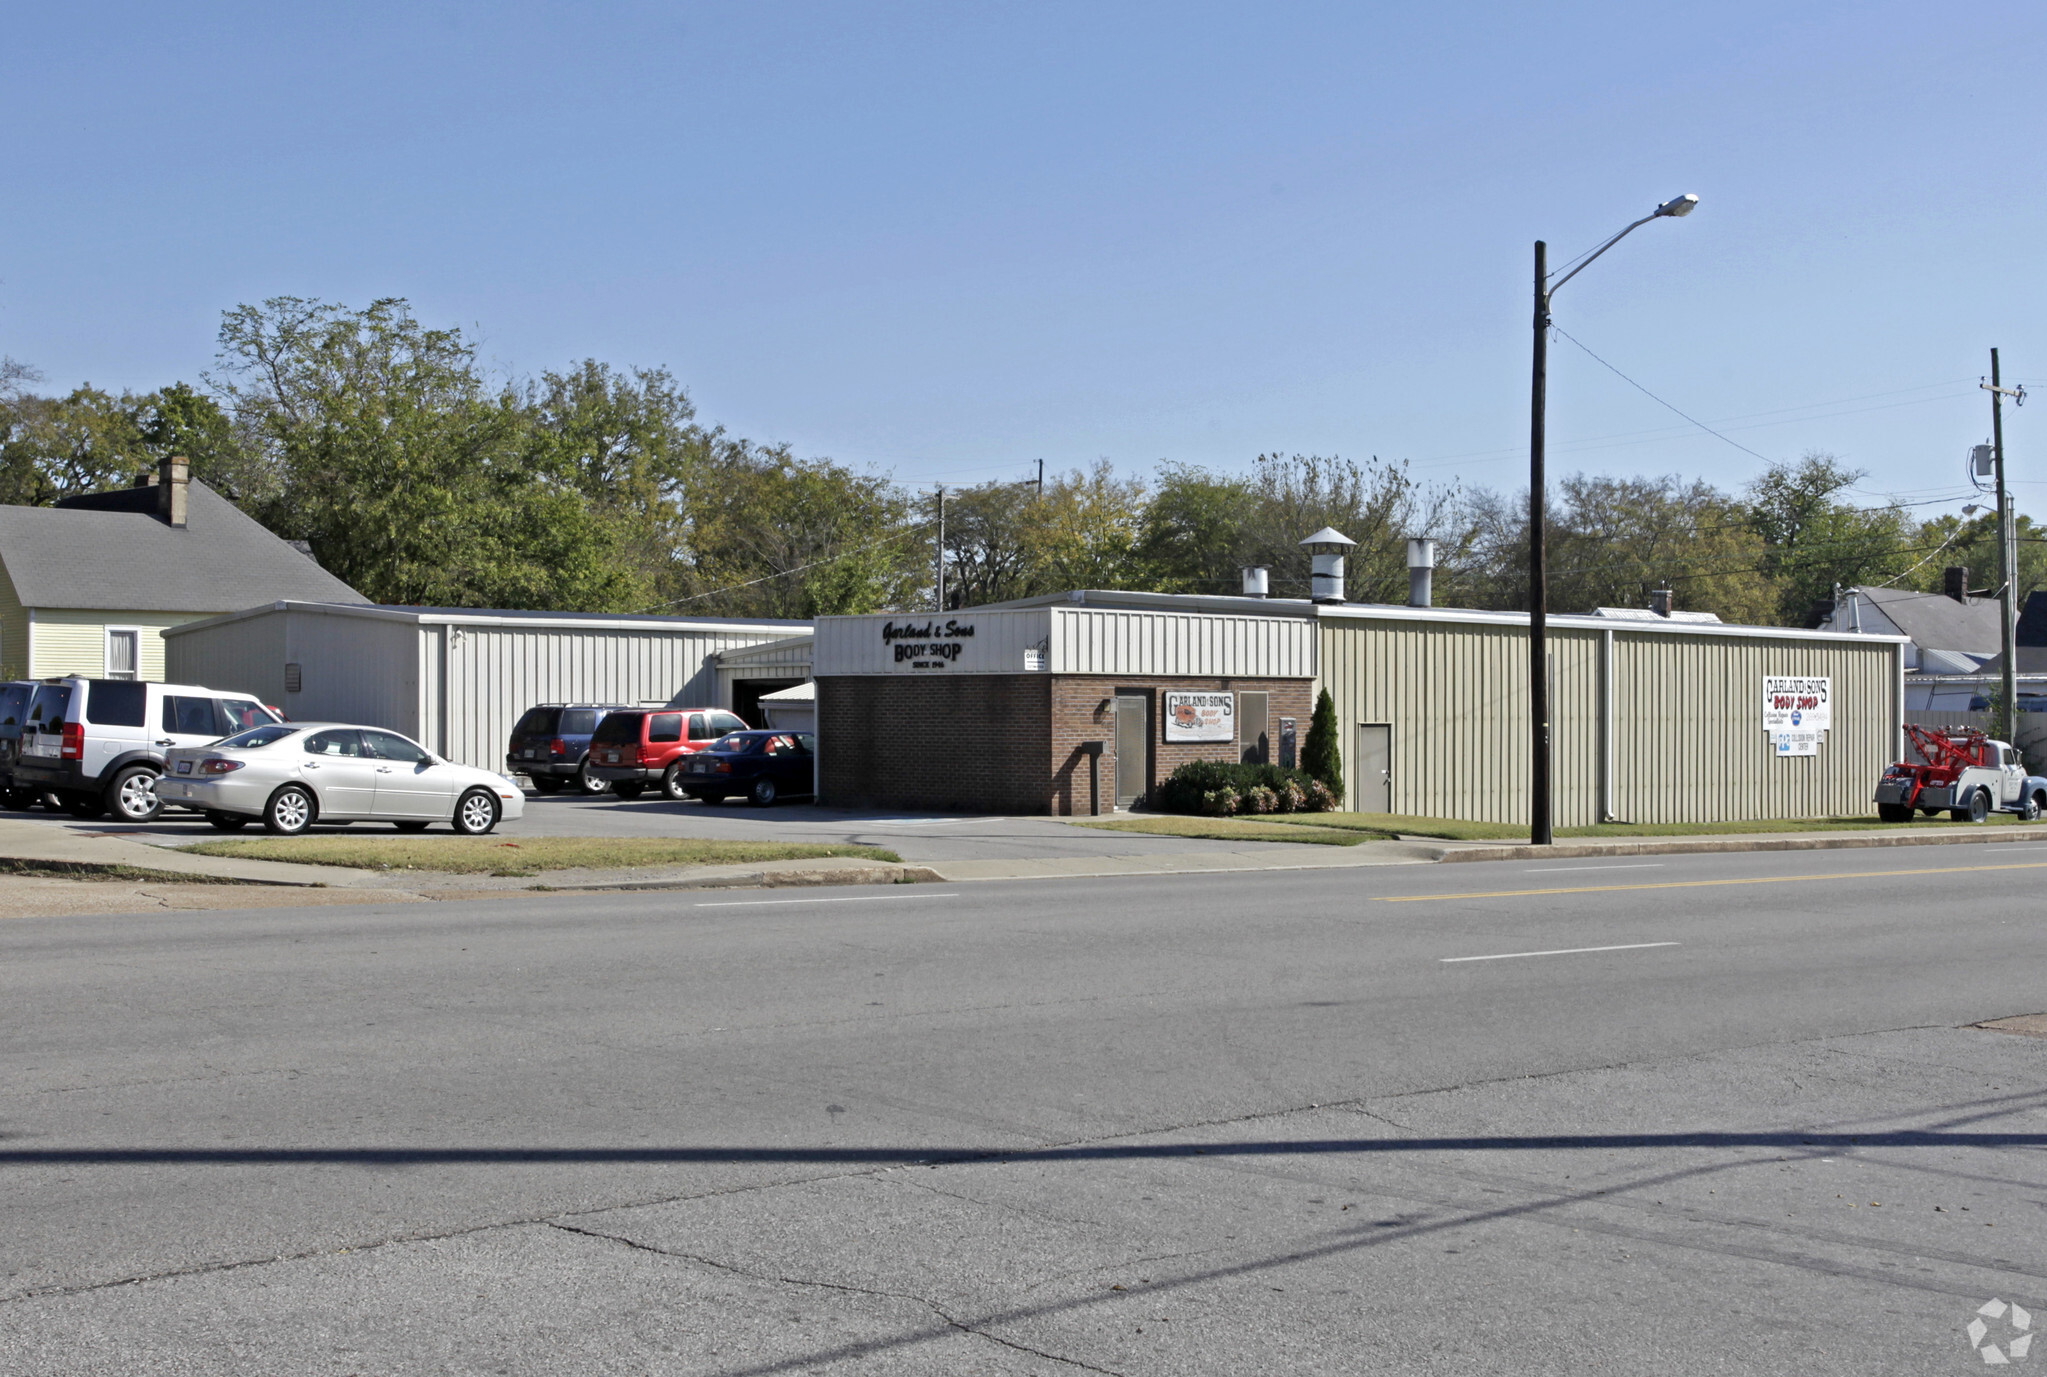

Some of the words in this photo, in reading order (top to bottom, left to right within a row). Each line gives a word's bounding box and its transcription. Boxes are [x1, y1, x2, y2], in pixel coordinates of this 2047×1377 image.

[883, 620, 931, 645] Garland
[934, 626, 941, 638] &
[944, 620, 974, 638] Sons
[894, 643, 926, 662] BODY
[929, 643, 962, 661] SHOP
[1766, 679, 1804, 702] GARLAND
[1807, 680, 1827, 702] SONS
[1169, 695, 1206, 716] GARLAND
[1209, 696, 1232, 716] SONS
[1774, 695, 1795, 710] BODY
[1796, 696, 1818, 710] SHOP
[1201, 709, 1218, 717] BODY
